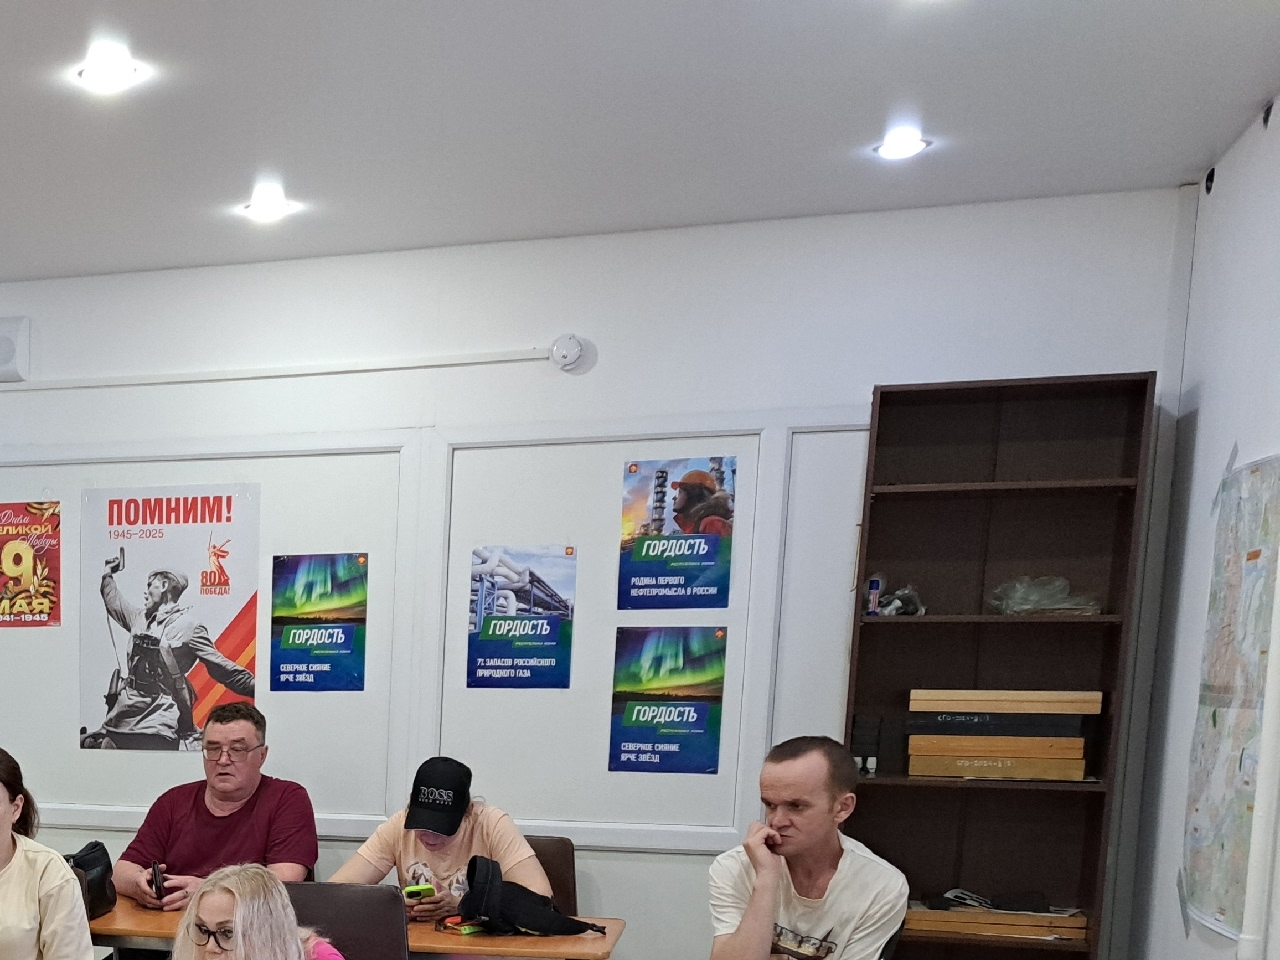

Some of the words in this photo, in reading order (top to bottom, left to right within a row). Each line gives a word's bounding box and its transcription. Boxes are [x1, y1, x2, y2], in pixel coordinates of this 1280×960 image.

[108, 495, 232, 526] ПОМНИМ!
[642, 539, 709, 558] ГОРДОСТЬ
[1, 540, 35, 591] 9
[631, 577, 657, 586] РОДИНА
[657, 576, 685, 585] ПЕРВОГО
[200, 587, 230, 597] ПОБЕДА!
[288, 628, 345, 646] ГОРДОСТЬ
[489, 620, 551, 638] ГОРДОСТЬ
[516, 669, 531, 678] ГАЗА
[632, 705, 698, 724] ГОРДОСТЬ
[620, 753, 637, 762] ЯРЧЕ
[420, 786, 454, 801] BOSS
